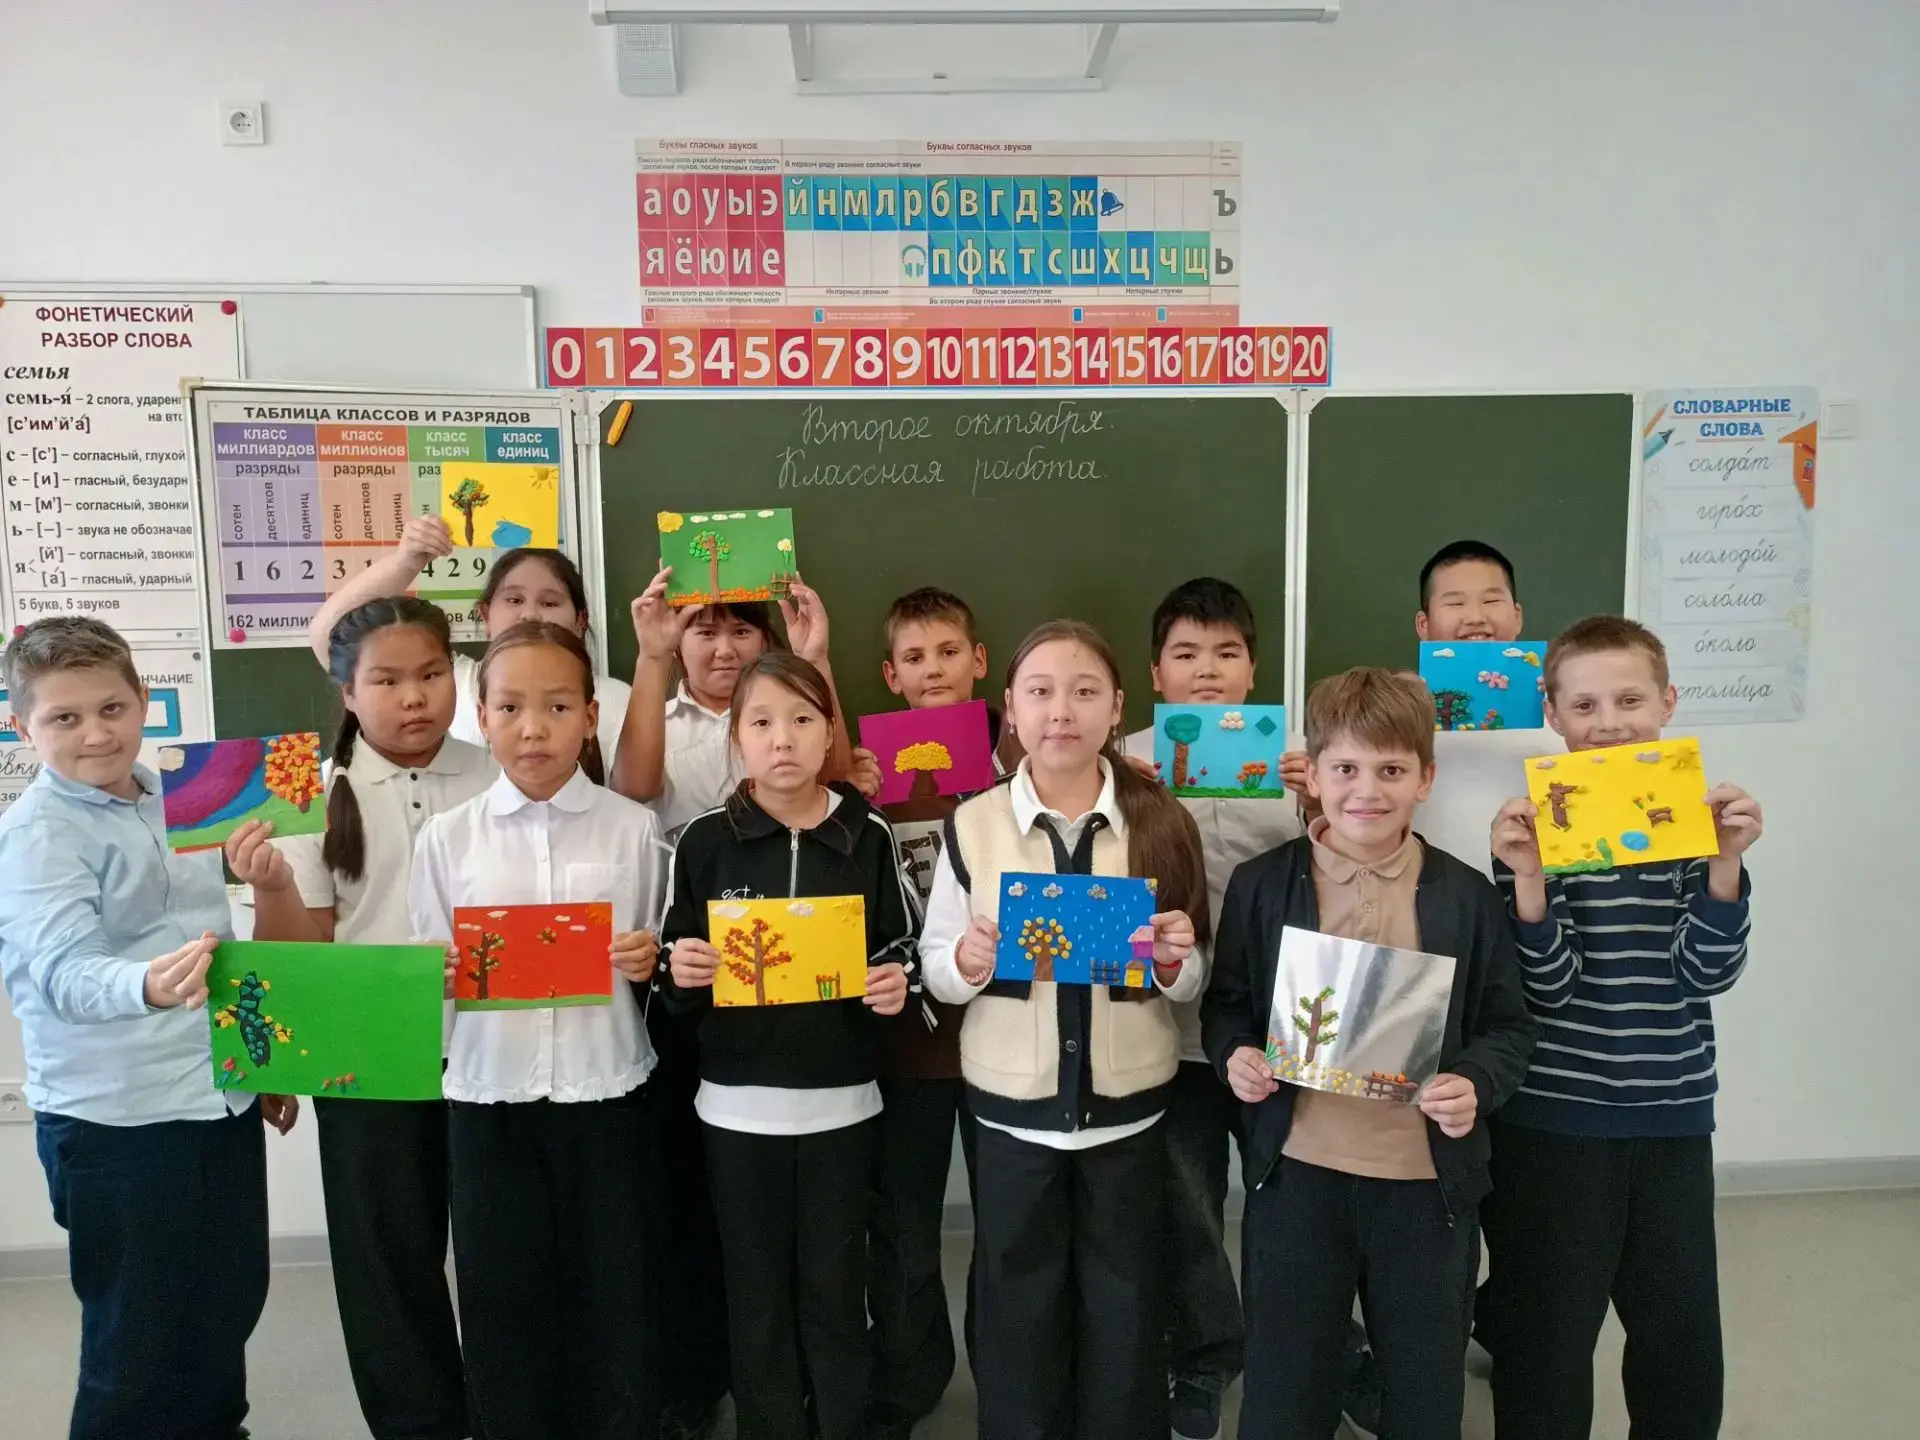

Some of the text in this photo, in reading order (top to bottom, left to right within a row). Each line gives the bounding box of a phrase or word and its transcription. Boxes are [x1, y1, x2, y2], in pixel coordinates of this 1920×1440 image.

[659, 140, 758, 151] Буквы гласных звуков
[927, 142, 1032, 153] Буквы согласных звуков
[36, 304, 194, 323] ФОНЕТИЧЕСКИЙ
[42, 332, 192, 348] РАЗБОР СЛОВА
[552, 335, 1326, 379] 0 1 2 3 4 5 6 7 8 9 10 11 12 13 14 15 16 17 18 19 20
[4, 366, 69, 380] семья
[87, 394, 94, 405] 2
[97, 395, 134, 407] слога,
[1673, 399, 1791, 414] СЛОВАРНЫЕ
[148, 413, 162, 422] на
[244, 406, 531, 425] ТАБЛИЦА КЛАССОВ И РАЗРЯДОВ
[244, 428, 288, 440] класс
[802, 402, 932, 453] Второе
[1700, 422, 1764, 437] СЛОВА
[341, 430, 383, 441] класс
[426, 431, 466, 442] класс
[503, 432, 542, 443] класс
[73, 448, 142, 463] согласный,
[145, 450, 186, 464] глухой
[218, 444, 315, 458] миллиардов
[320, 445, 406, 457] миллионов
[424, 446, 470, 457] тысяч
[498, 447, 550, 460] единиц
[236, 464, 300, 477] разряды
[334, 464, 396, 477] разряды
[776, 446, 944, 490] Классная
[74, 474, 130, 488] гласный,
[132, 474, 188, 488] безударн
[76, 499, 144, 512] согласный,
[265, 482, 278, 540] десятков
[362, 482, 374, 540] десятков
[233, 504, 244, 540] сотен
[300, 492, 312, 540] единиц
[332, 504, 343, 540] сотен
[78, 526, 110, 538] звука
[114, 526, 128, 536] не
[80, 548, 148, 562] согласный,
[235, 560, 244, 581] 1
[266, 560, 281, 581] 6
[301, 560, 314, 580] 2
[332, 559, 346, 580] 3
[448, 558, 460, 578] 2
[473, 557, 486, 577] 9
[82, 573, 137, 586] гласный,
[140, 573, 192, 588] ударный
[19, 599, 120, 612] 5 букв, 5 звуков
[228, 614, 314, 628] 162 милли
[138, 673, 194, 684] НЧАНИЕ
